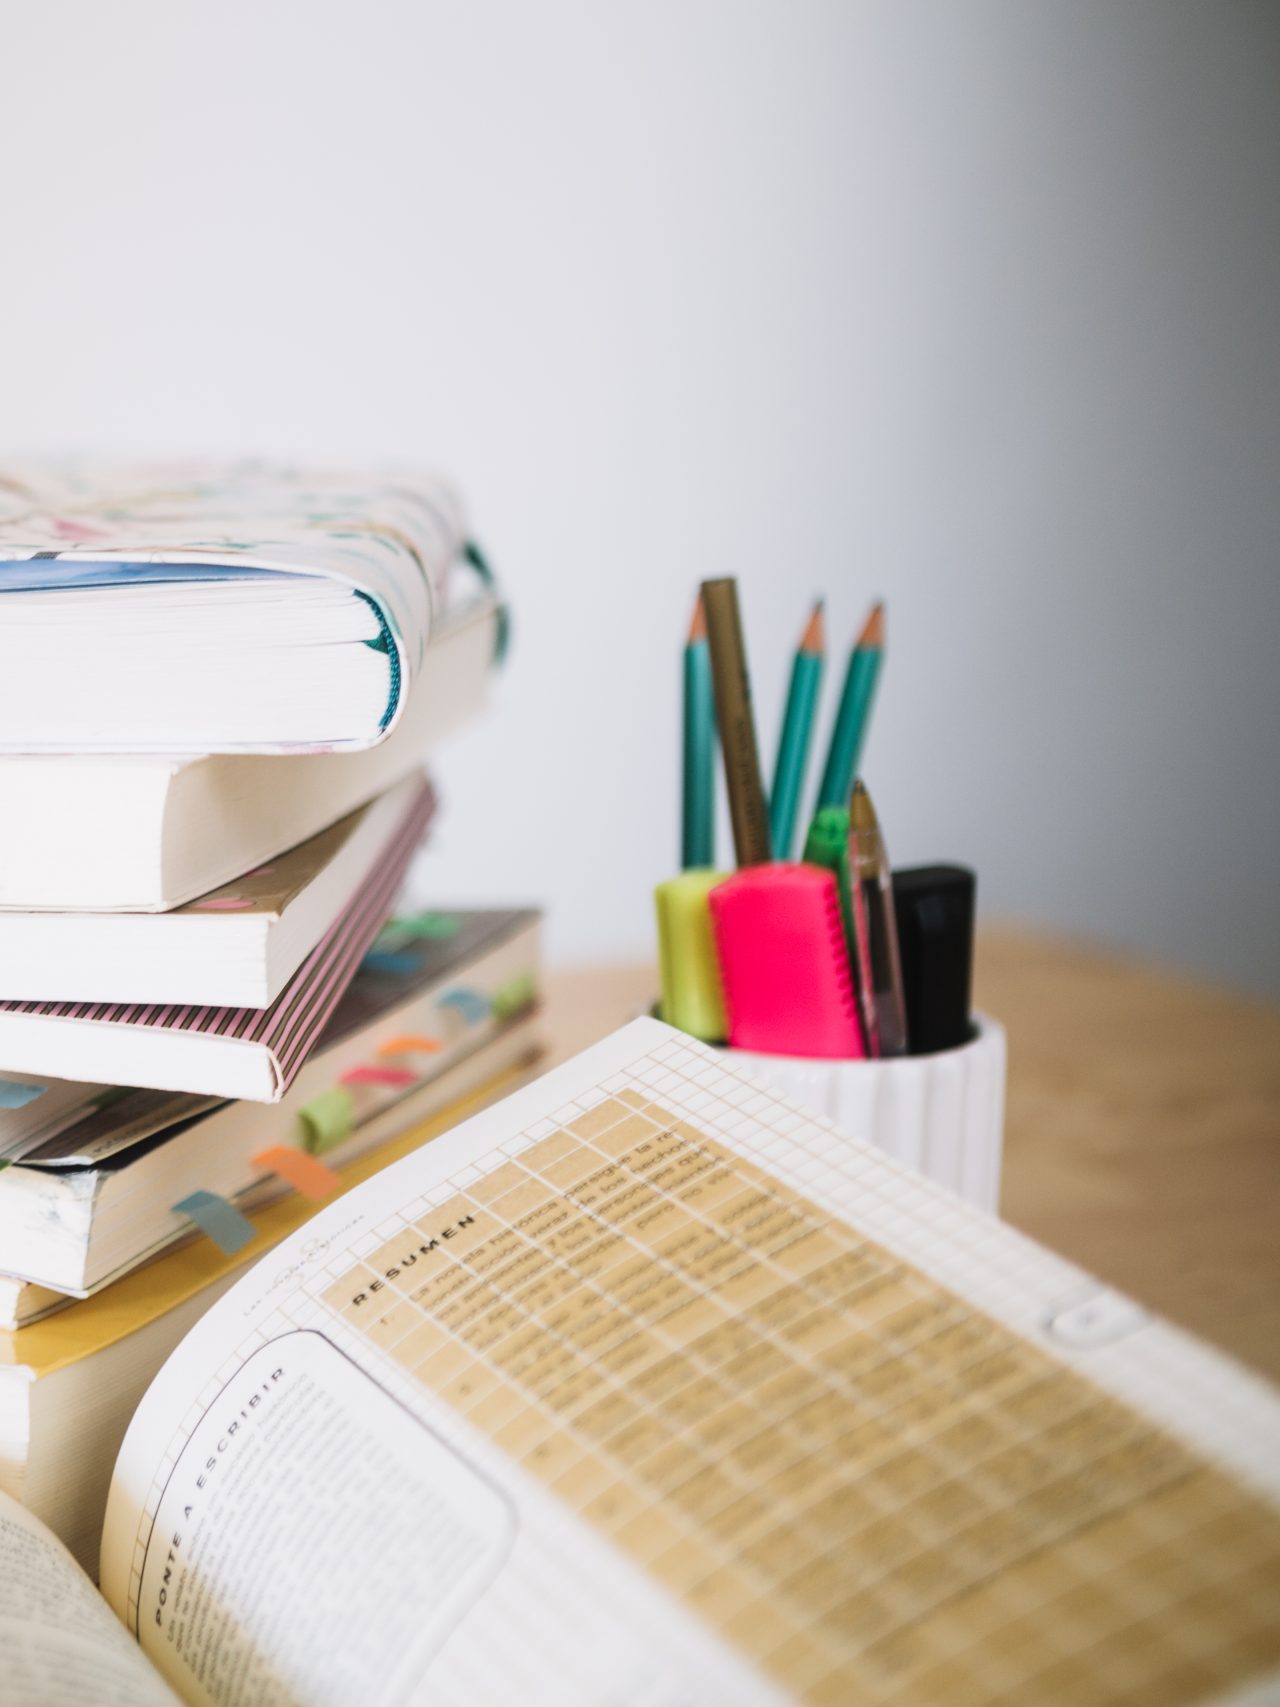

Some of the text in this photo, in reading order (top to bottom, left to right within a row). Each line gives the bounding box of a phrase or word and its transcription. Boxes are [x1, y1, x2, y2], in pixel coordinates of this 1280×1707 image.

[559, 1153, 636, 1202] persigue
[631, 1141, 654, 1156] la
[352, 1214, 476, 1307] RESUMEN
[155, 1367, 285, 1627] PONTE A ESCRIBIR
